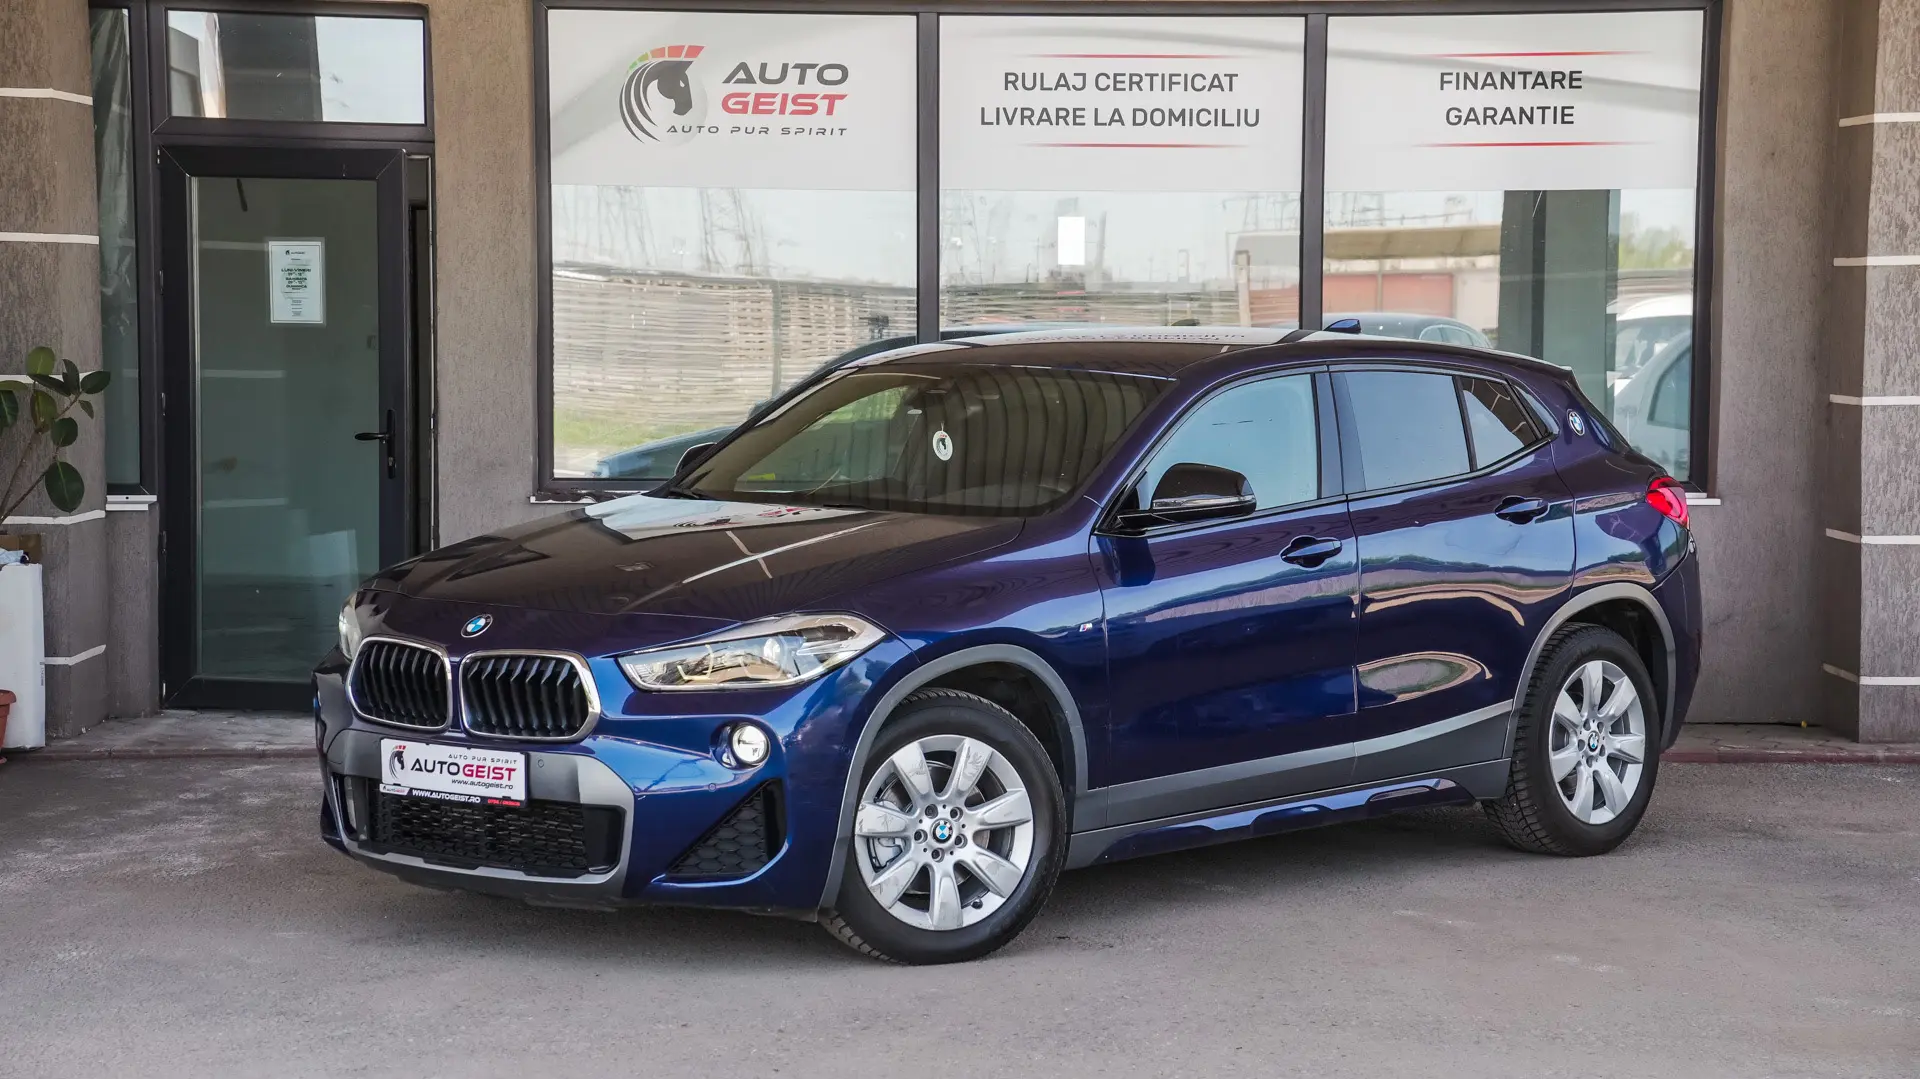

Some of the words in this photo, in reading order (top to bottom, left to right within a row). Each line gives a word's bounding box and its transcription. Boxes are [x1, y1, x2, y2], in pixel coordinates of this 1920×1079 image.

[722, 61, 849, 86] AUTO
[1004, 72, 1087, 92] RULAJ
[1094, 72, 1239, 92] CERTIFICAT
[1440, 70, 1583, 91] FINANTARE
[721, 92, 848, 116] GEIST
[980, 106, 1086, 126] LIVRARE
[1093, 107, 1126, 127] LA
[1132, 108, 1260, 128] DOMICILIU
[1445, 105, 1575, 126] GARANTIE
[666, 125, 720, 135] AUTO
[730, 126, 770, 135] PUR
[780, 127, 848, 136] SPIRIT
[448, 753, 468, 761] AUTO
[410, 758, 517, 782] AUTOGEIST
[451, 778, 514, 791] www.autogeist.ro
